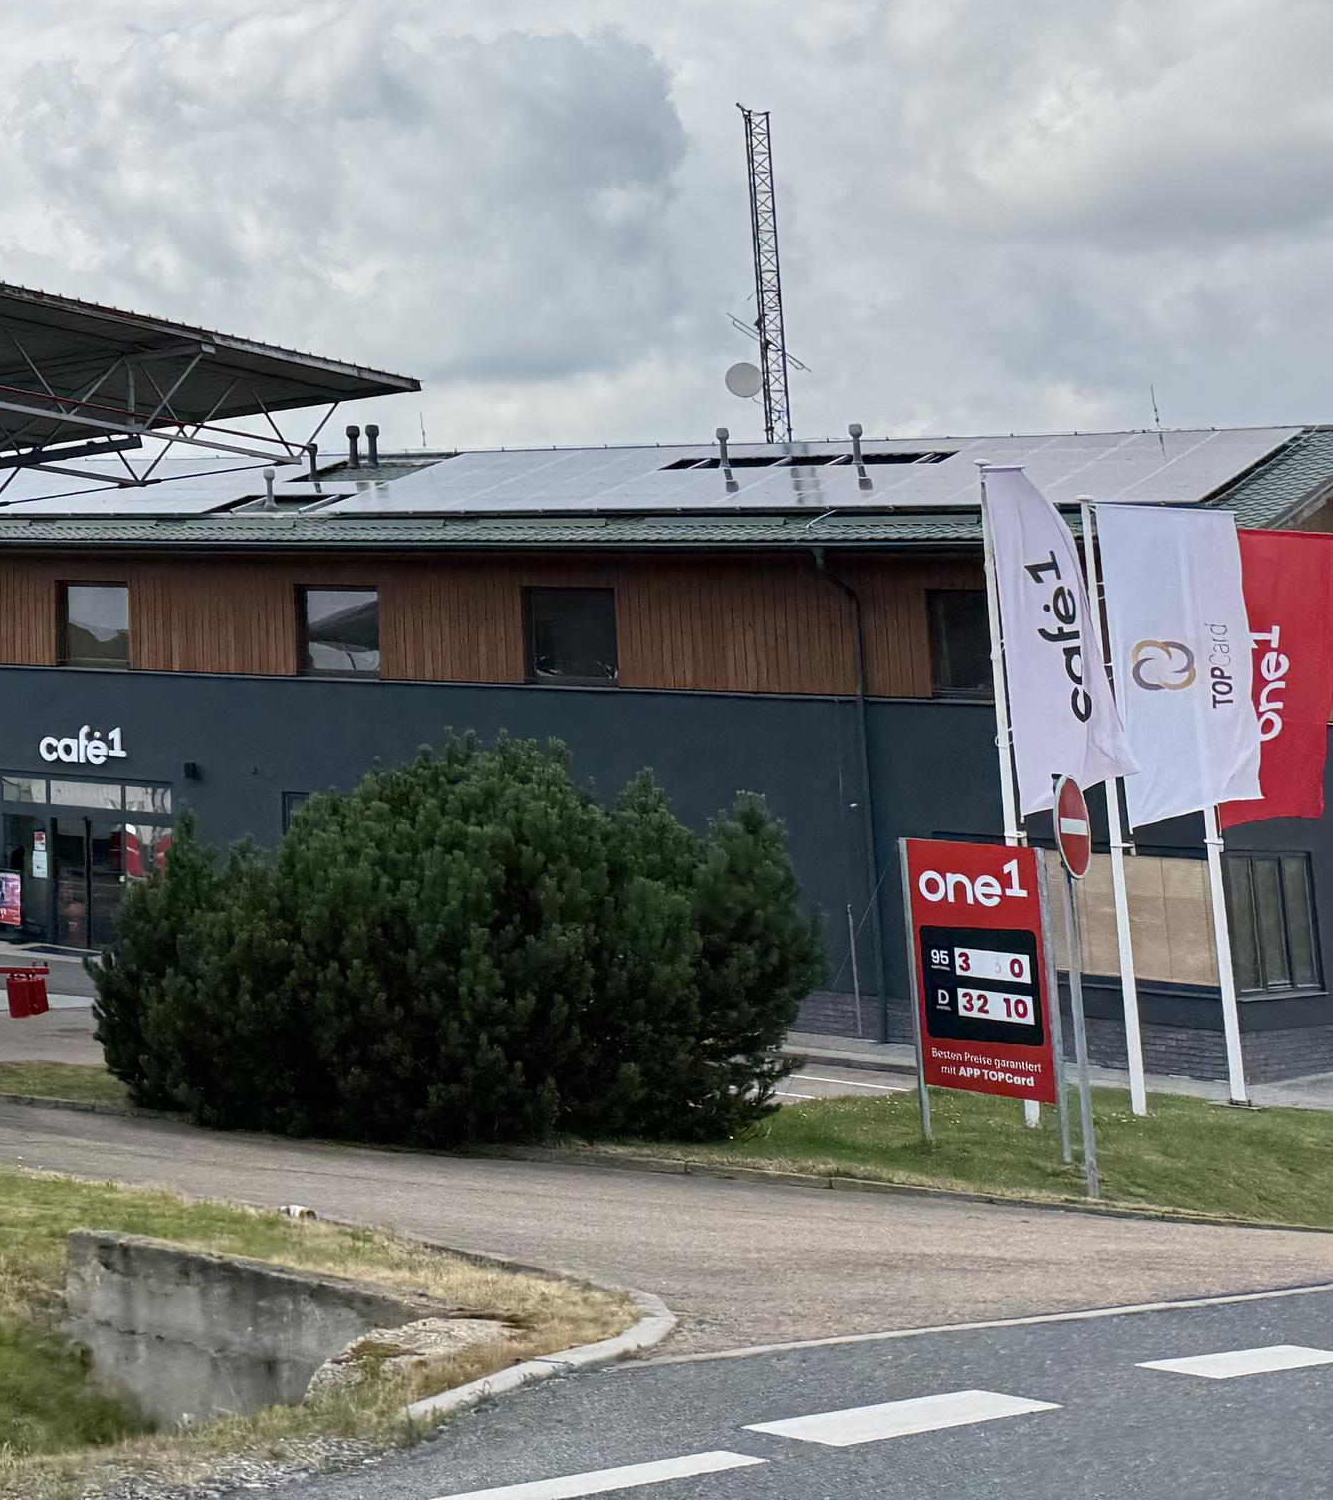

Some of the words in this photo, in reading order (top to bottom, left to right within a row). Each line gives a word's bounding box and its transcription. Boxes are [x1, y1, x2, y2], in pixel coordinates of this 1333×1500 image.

[1204, 622, 1234, 709] TOPCard
[931, 949, 949, 965] 95
[938, 989, 950, 1005] D
[962, 992, 990, 1014] 32
[1003, 997, 1029, 1019] 10
[932, 1047, 963, 1062] Besten
[964, 1051, 993, 1066] Preise
[995, 1058, 1042, 1073] garantiert
[941, 1065, 957, 1075] mit
[958, 1066, 981, 1078] APP
[982, 1069, 1035, 1087] TOPCard
